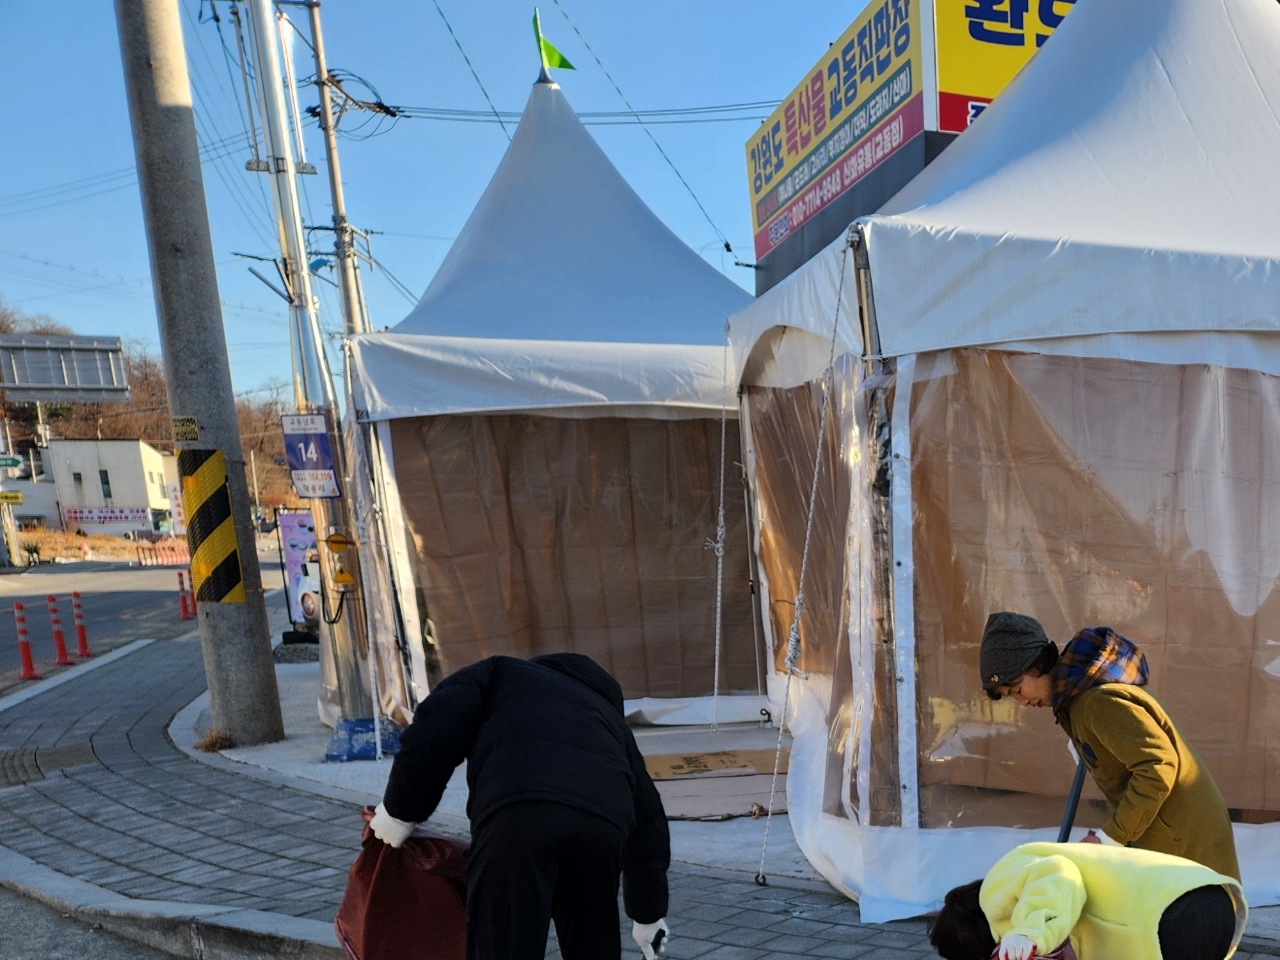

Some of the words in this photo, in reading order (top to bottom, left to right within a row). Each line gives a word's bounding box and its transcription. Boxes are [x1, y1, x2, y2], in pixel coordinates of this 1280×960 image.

[751, 120, 784, 195] 강원도
[784, 69, 826, 156] 특산물
[827, 0, 910, 121] 교동직판장
[298, 441, 318, 462] 14
